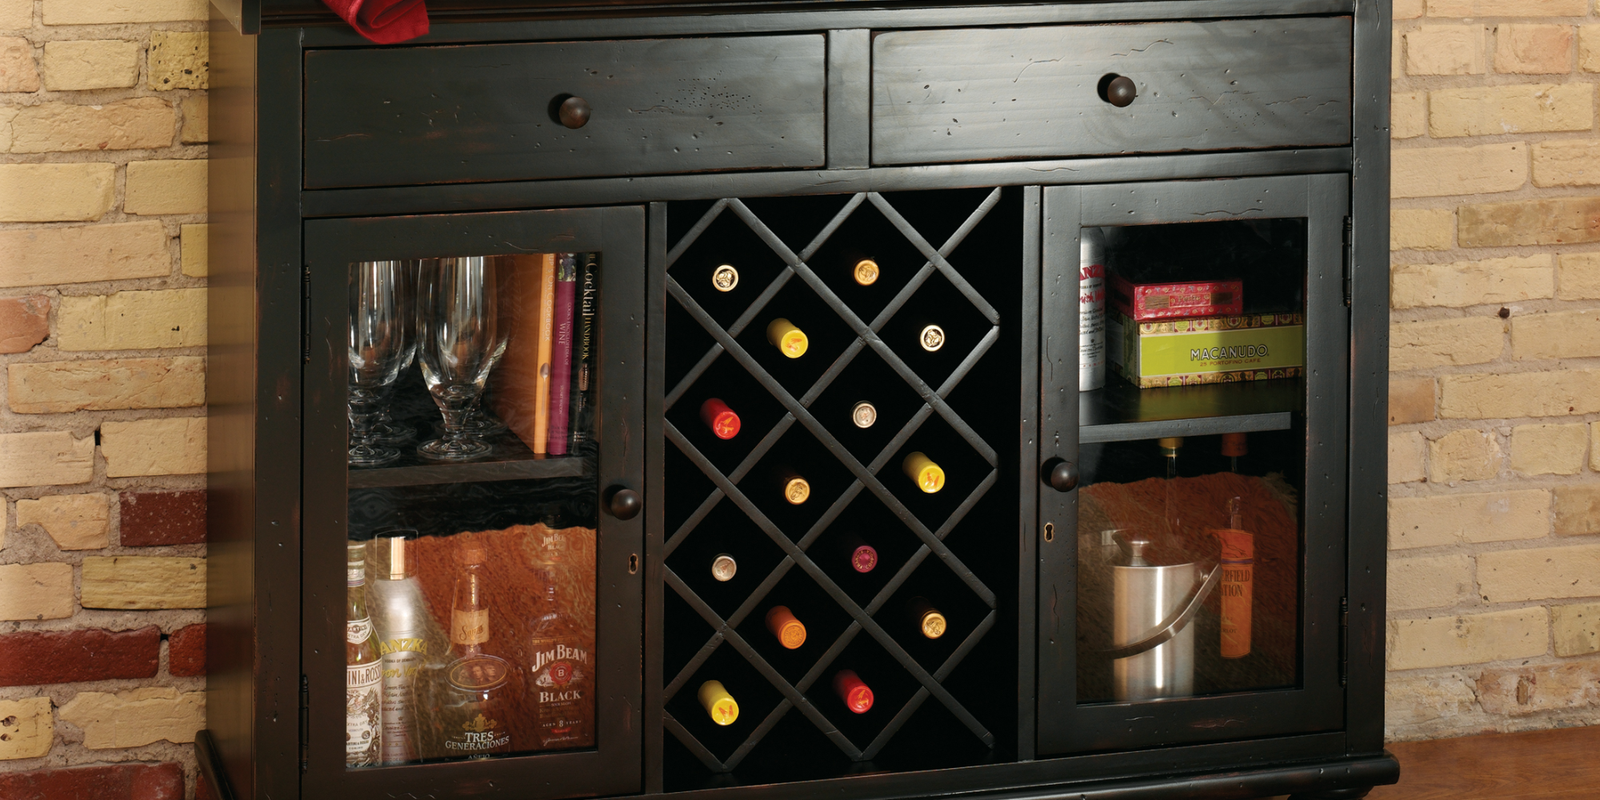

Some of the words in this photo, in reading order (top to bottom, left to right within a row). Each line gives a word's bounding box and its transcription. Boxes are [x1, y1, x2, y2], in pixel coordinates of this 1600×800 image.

[547, 254, 555, 274] UP'S
[582, 262, 598, 317] Cocktail
[544, 291, 554, 342] COOKBOOK
[558, 322, 566, 345] WINE
[582, 317, 592, 360] HANDBOOK
[1190, 343, 1267, 361] MACANUDO
[1209, 358, 1243, 366] PORTOFINO
[1221, 569, 1250, 583] ERFIELD
[380, 638, 428, 656] ANZKA
[531, 649, 555, 673] JIM
[556, 644, 588, 665] BEAM
[558, 669, 565, 677] B
[539, 690, 581, 703] BLACK
[558, 720, 564, 728] 8
[445, 735, 510, 751] GENERACIONES
[464, 730, 494, 743] TRES
